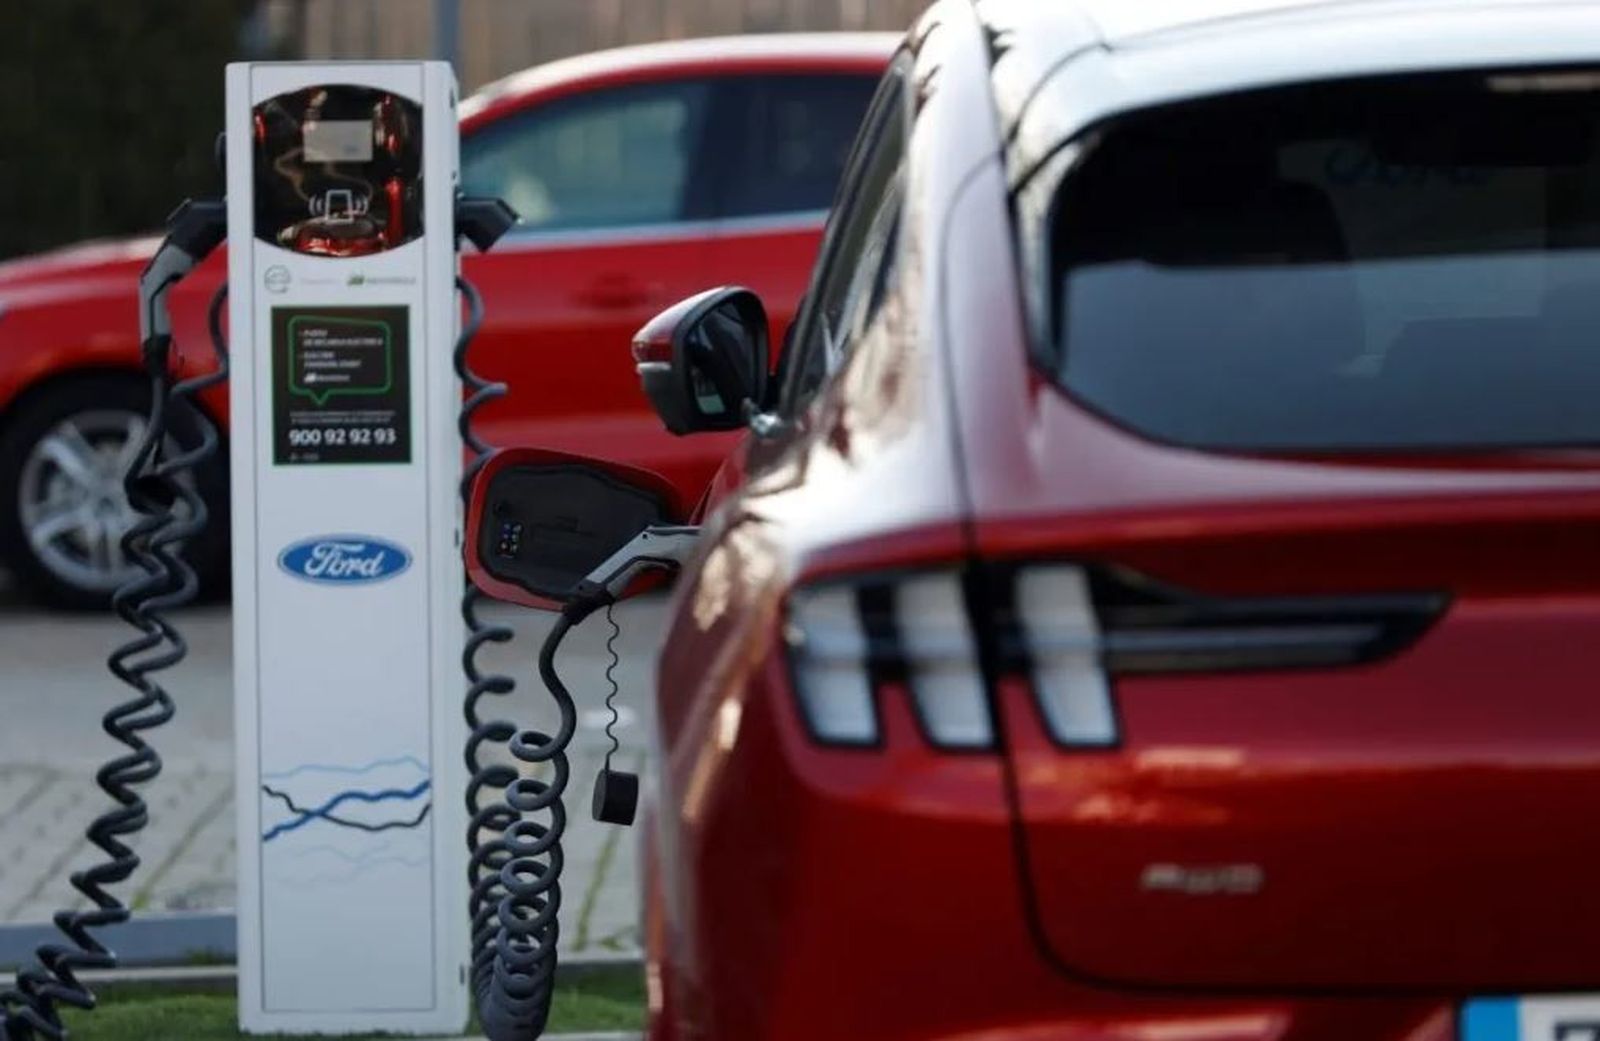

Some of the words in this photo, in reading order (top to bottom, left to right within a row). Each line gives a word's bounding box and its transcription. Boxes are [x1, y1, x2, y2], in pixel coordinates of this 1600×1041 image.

[289, 428, 322, 445] 900
[324, 428, 346, 445] 92
[349, 428, 371, 445] 92
[373, 428, 397, 445] 93
[304, 542, 385, 576] Ford
